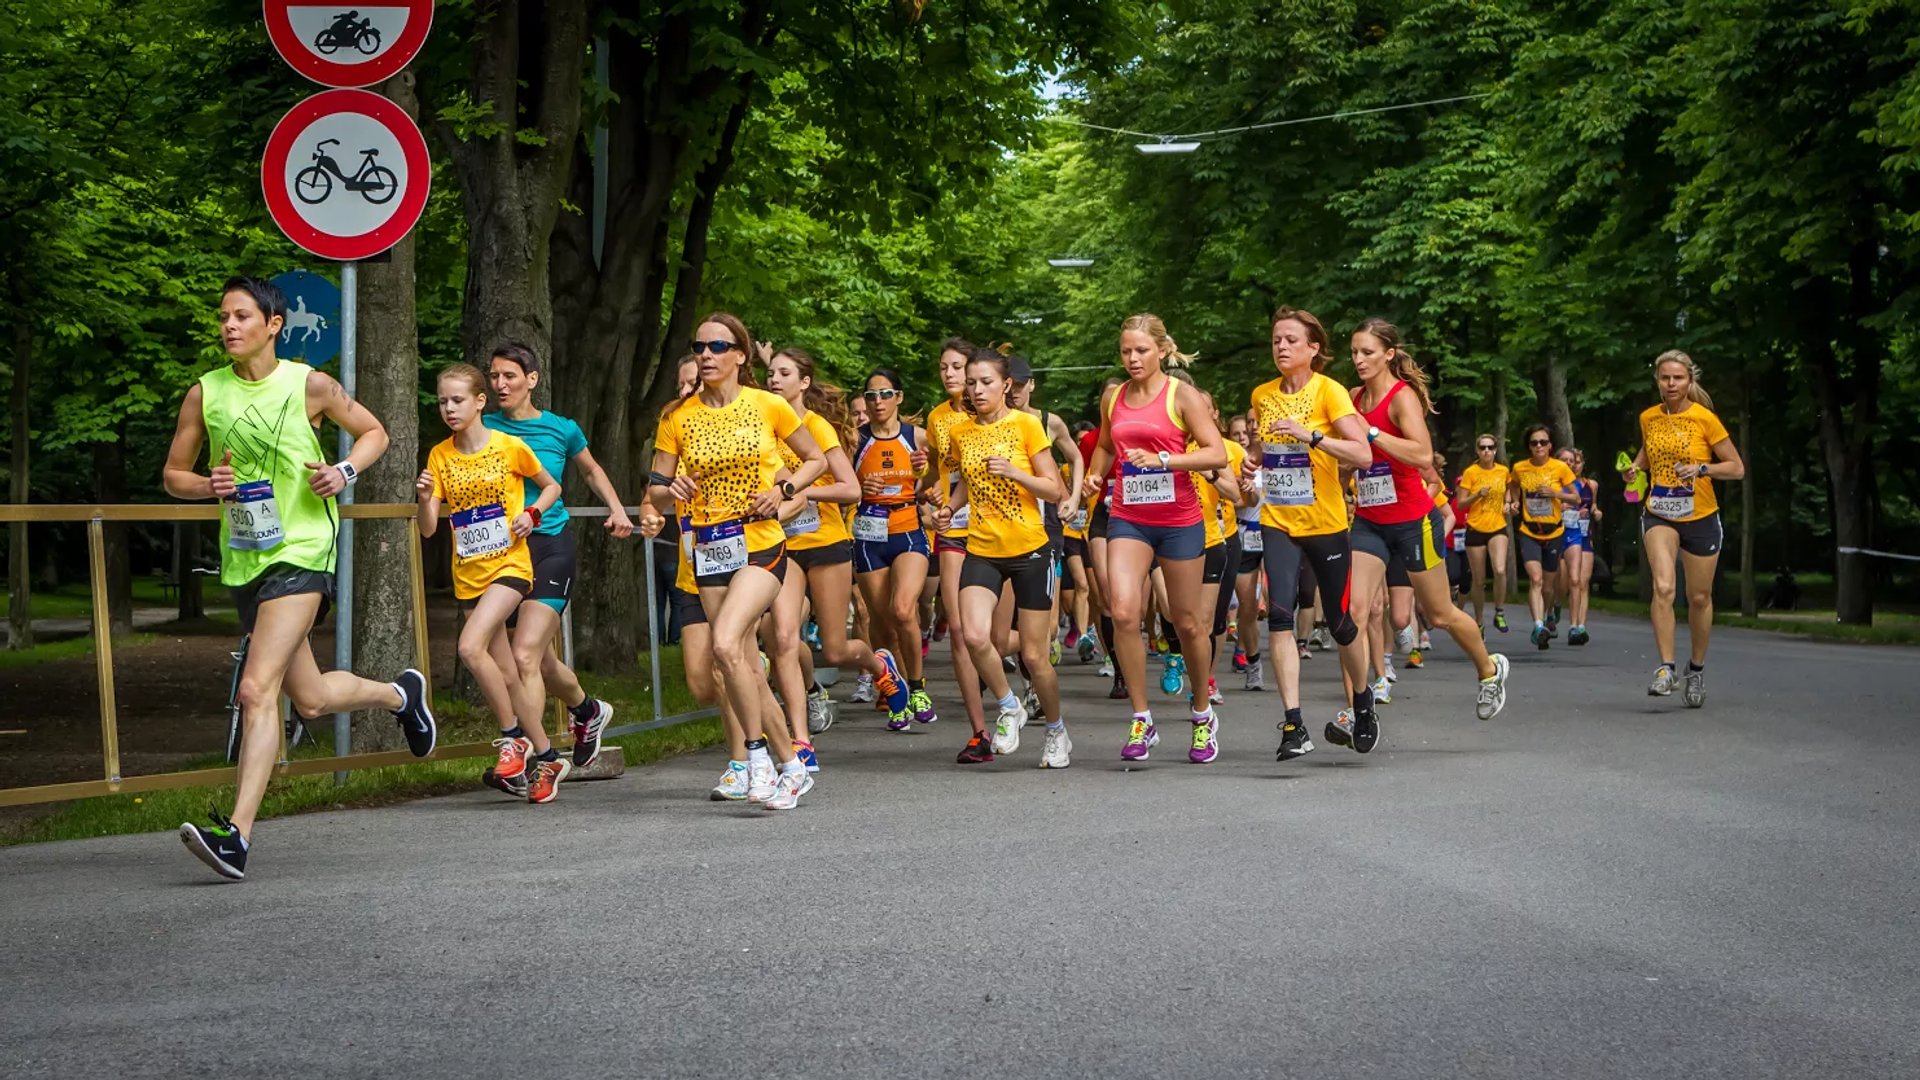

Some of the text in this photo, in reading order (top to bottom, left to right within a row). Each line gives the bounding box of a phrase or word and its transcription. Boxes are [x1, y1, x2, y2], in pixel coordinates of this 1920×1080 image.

[1125, 475, 1169, 494] 30164 A
[1266, 469, 1306, 487] 2343 A
[1382, 477, 1389, 486] A
[261, 502, 271, 514] A
[1652, 499, 1682, 511] 26325
[461, 520, 503, 546] 3030 A
[702, 537, 744, 562] 2769 A
